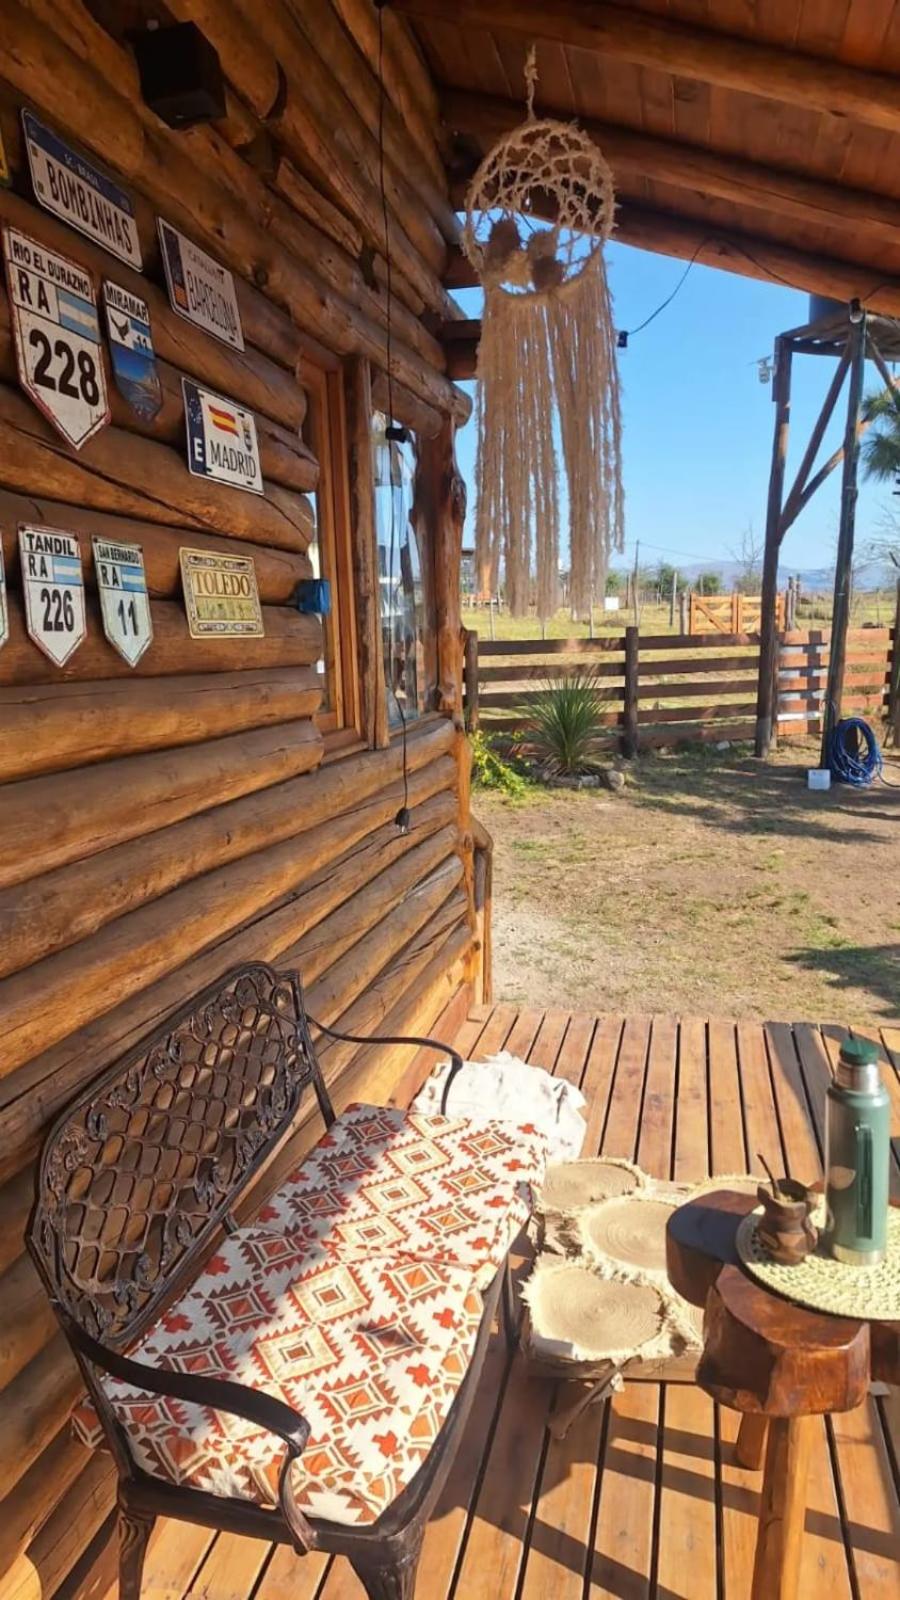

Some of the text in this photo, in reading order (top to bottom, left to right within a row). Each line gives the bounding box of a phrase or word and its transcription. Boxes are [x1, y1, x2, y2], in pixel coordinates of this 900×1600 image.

[46, 158, 133, 254] BOMBINHAS
[13, 240, 90, 297] RIO EL DURAZNO
[105, 285, 148, 323] MIRAMAR
[186, 270, 239, 337] BARCELONA
[29, 328, 100, 407] 228
[194, 437, 204, 462] E
[210, 440, 257, 479] MADRID
[26, 532, 75, 556] TANDIL
[98, 545, 140, 565] SAN BERNARDO
[192, 570, 251, 597] TOLEDO
[41, 588, 75, 632] 226
[118, 599, 139, 637] 11
